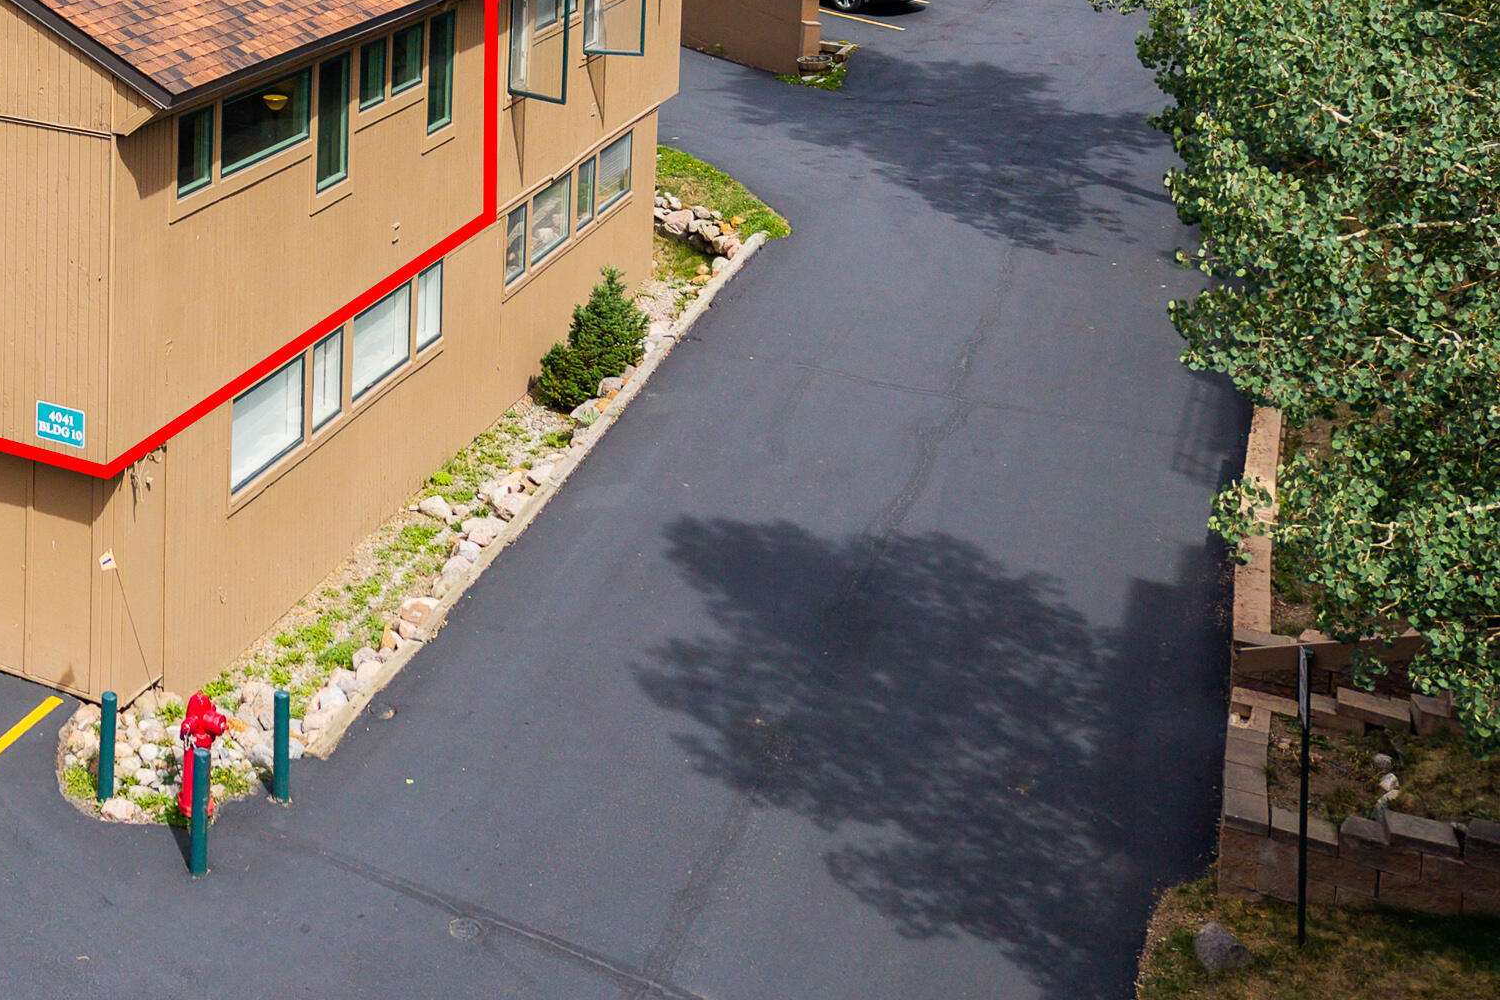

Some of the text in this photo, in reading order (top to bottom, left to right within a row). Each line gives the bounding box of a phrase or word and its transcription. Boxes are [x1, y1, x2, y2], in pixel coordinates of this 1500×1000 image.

[48, 411, 74, 427] 4041
[38, 420, 83, 441] BLDG 10
